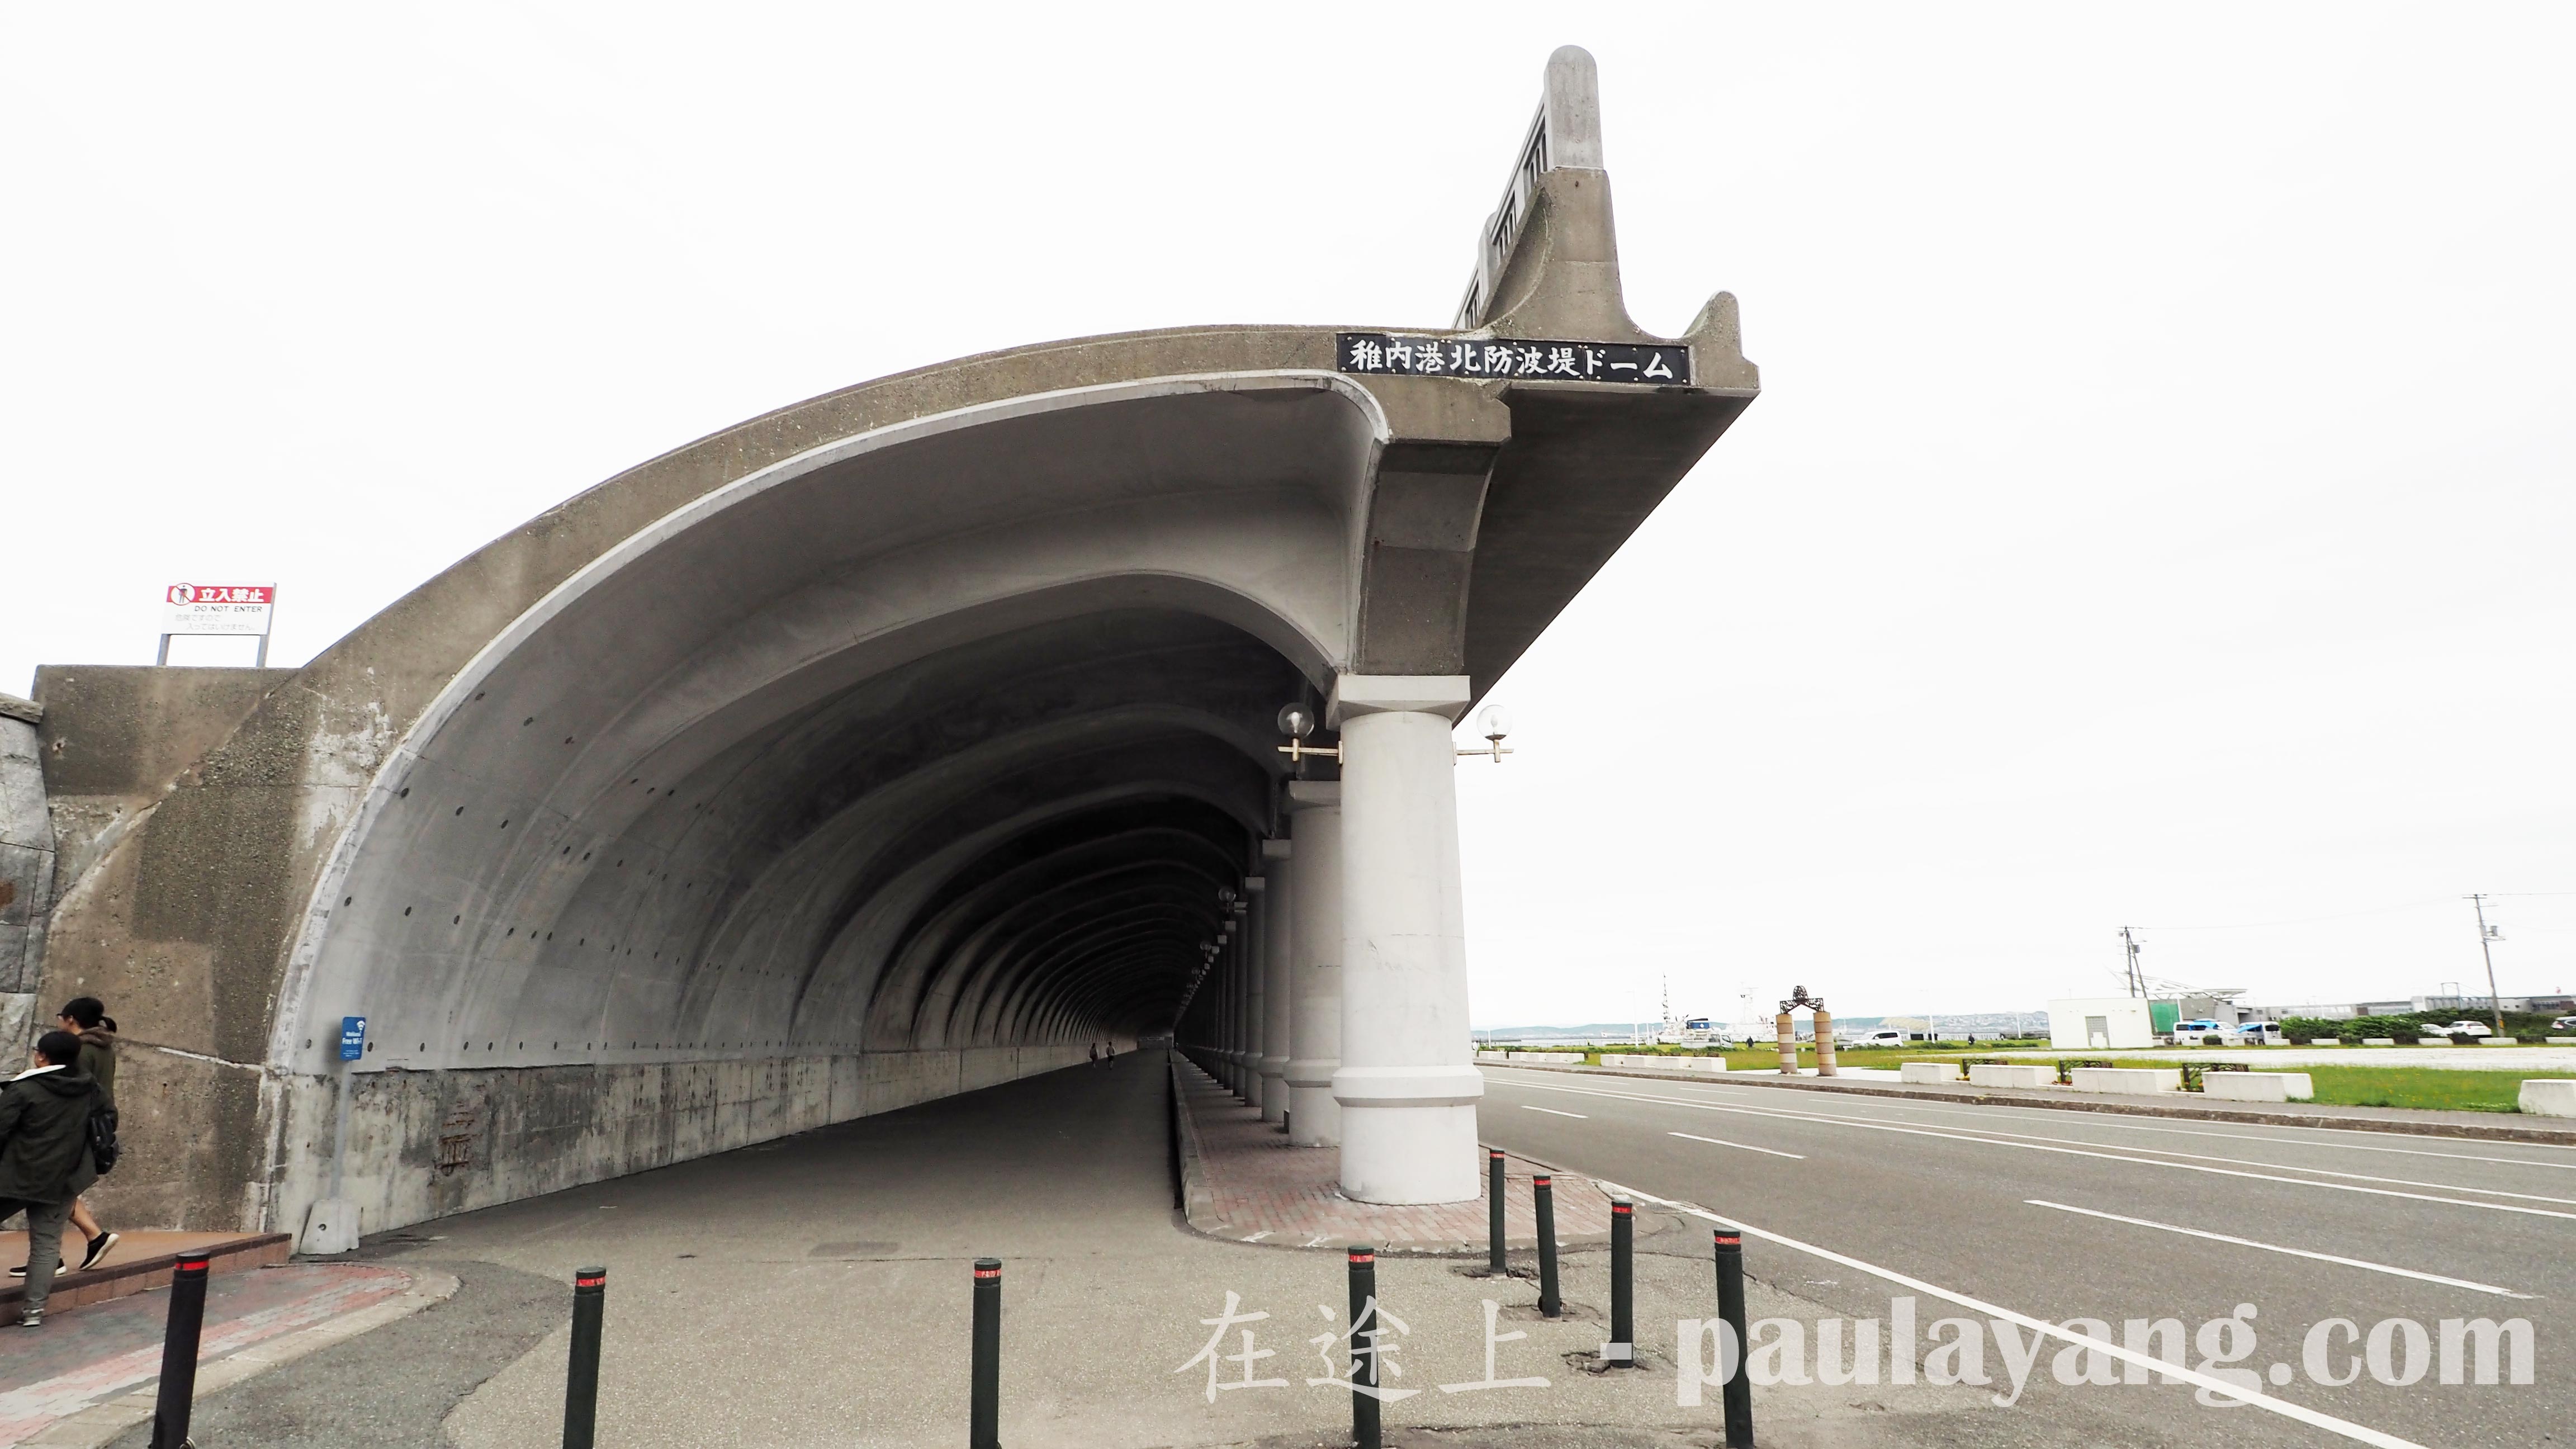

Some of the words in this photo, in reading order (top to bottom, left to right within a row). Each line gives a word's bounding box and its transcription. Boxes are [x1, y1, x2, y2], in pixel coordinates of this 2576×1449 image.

[1349, 339, 1674, 379] 稚内港北防波堤ドーム
[198, 588, 264, 603] 立入禁止
